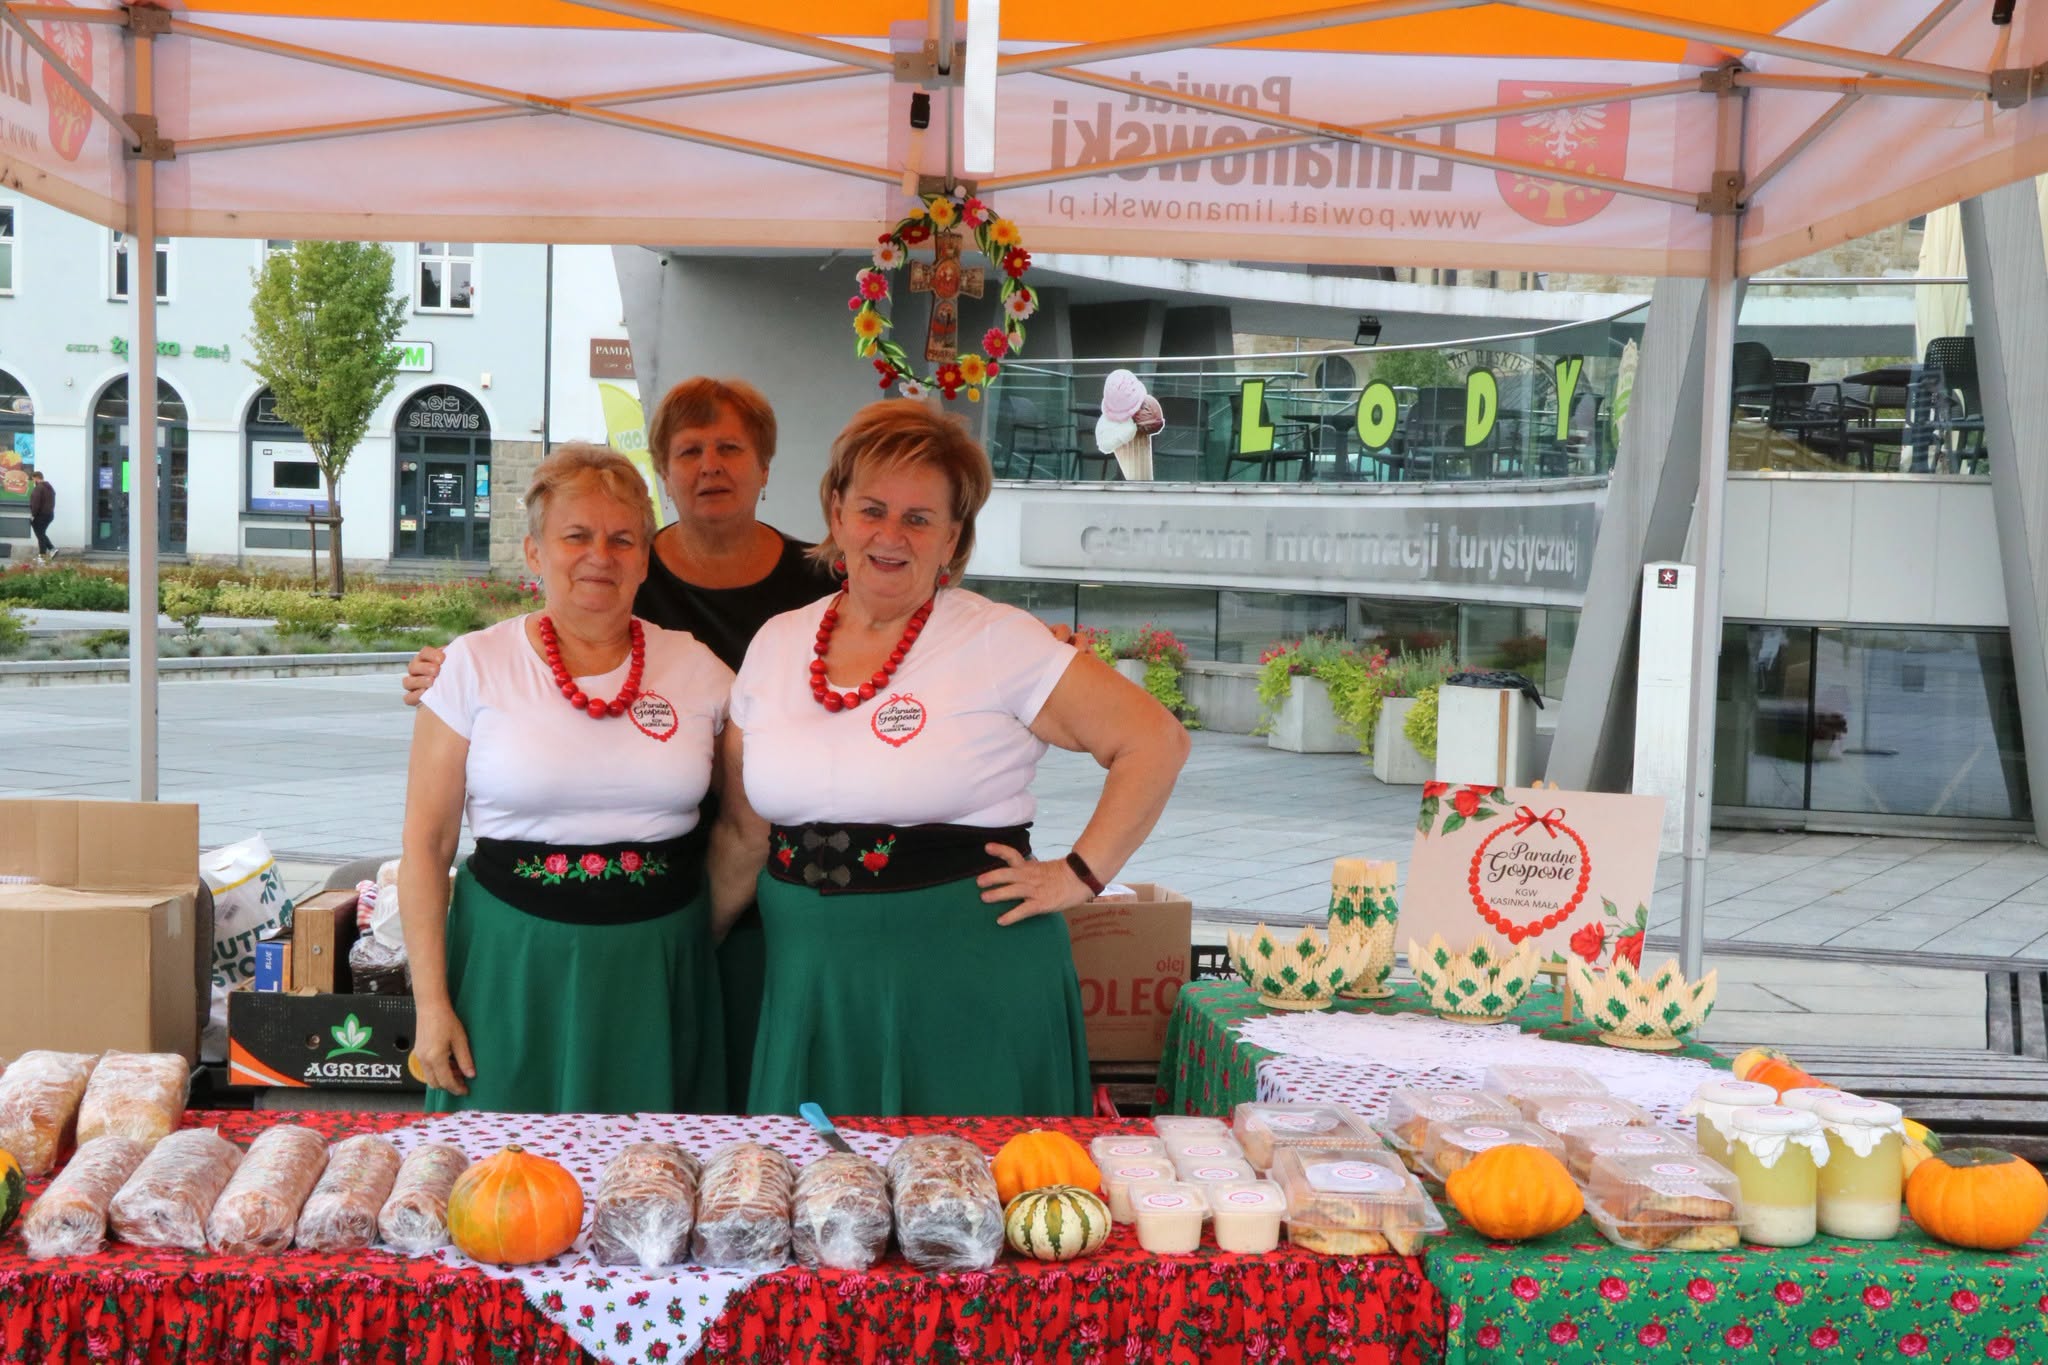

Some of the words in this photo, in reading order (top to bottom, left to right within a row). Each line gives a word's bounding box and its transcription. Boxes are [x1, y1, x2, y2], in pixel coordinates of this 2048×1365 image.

[1239, 354, 1584, 454] LODY
[409, 412, 480, 429] SERWIS
[1080, 519, 1251, 562] centrum
[1264, 519, 1440, 579] informacji
[1448, 520, 1580, 584] turystycznej
[1509, 841, 1577, 864] Paradne
[1483, 851, 1575, 885] Gosposie
[1490, 897, 1530, 907] KASINKA
[1532, 900, 1559, 909] MAŁA
[1515, 888, 1538, 897] KGW
[264, 950, 273, 970] BLUE
[1156, 954, 1184, 976] olej
[303, 1062, 402, 1078] AGREEN
